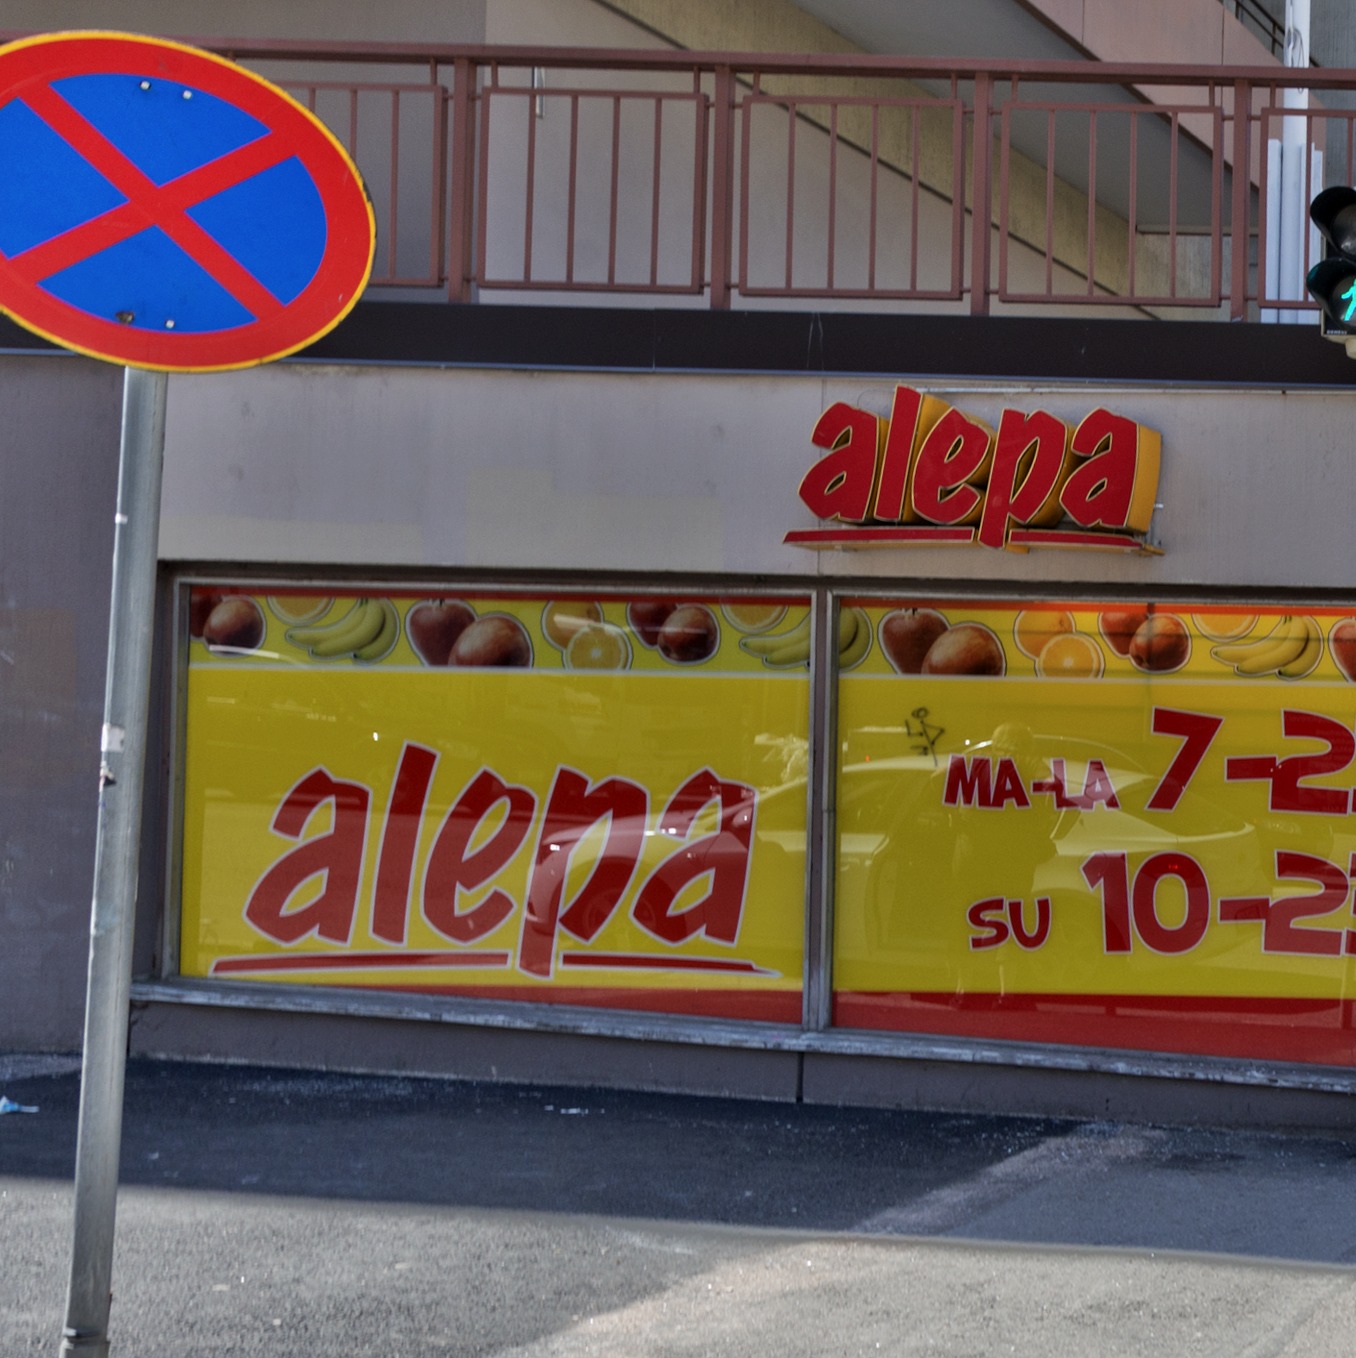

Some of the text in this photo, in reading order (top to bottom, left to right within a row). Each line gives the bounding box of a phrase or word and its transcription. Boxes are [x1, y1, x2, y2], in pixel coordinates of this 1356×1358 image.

[798, 385, 1142, 549] alepa
[943, 752, 1122, 812] MA-LA
[242, 740, 759, 980] alepa
[965, 898, 1051, 952] SU
